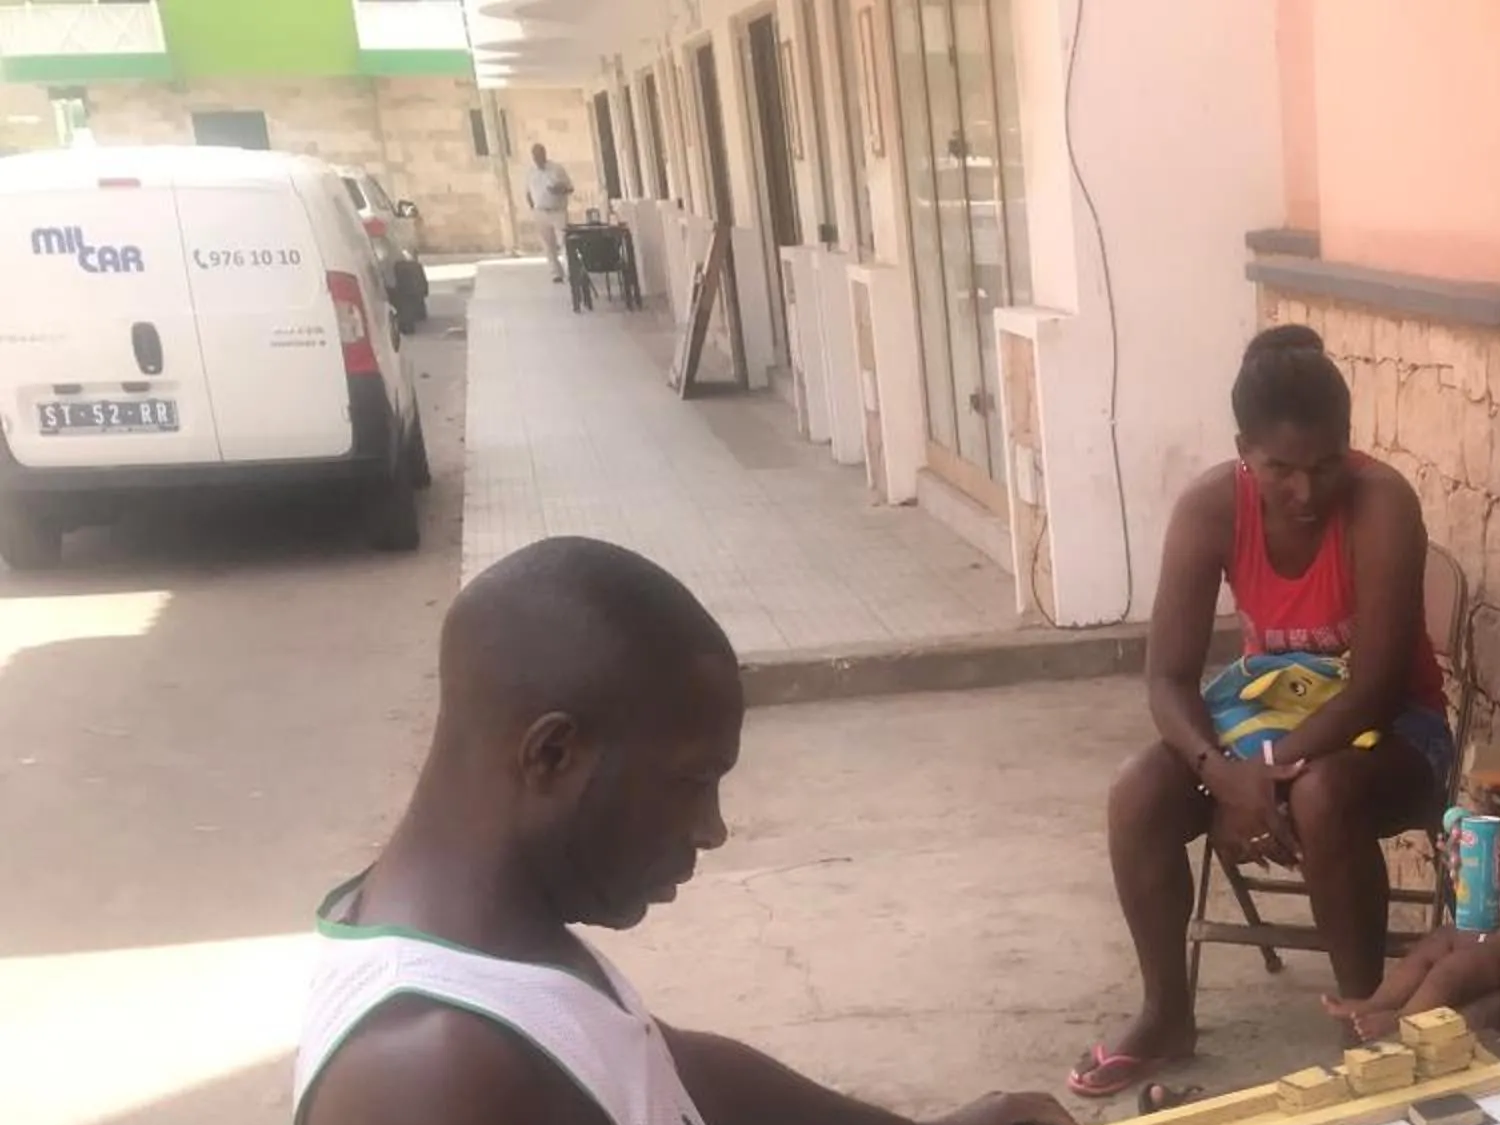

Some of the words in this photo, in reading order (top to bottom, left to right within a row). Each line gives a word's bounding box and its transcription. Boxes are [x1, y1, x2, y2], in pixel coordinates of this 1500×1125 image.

[77, 245, 145, 273] CAR
[209, 250, 245, 267] 976
[252, 250, 273, 266] 10
[281, 249, 301, 266] 10
